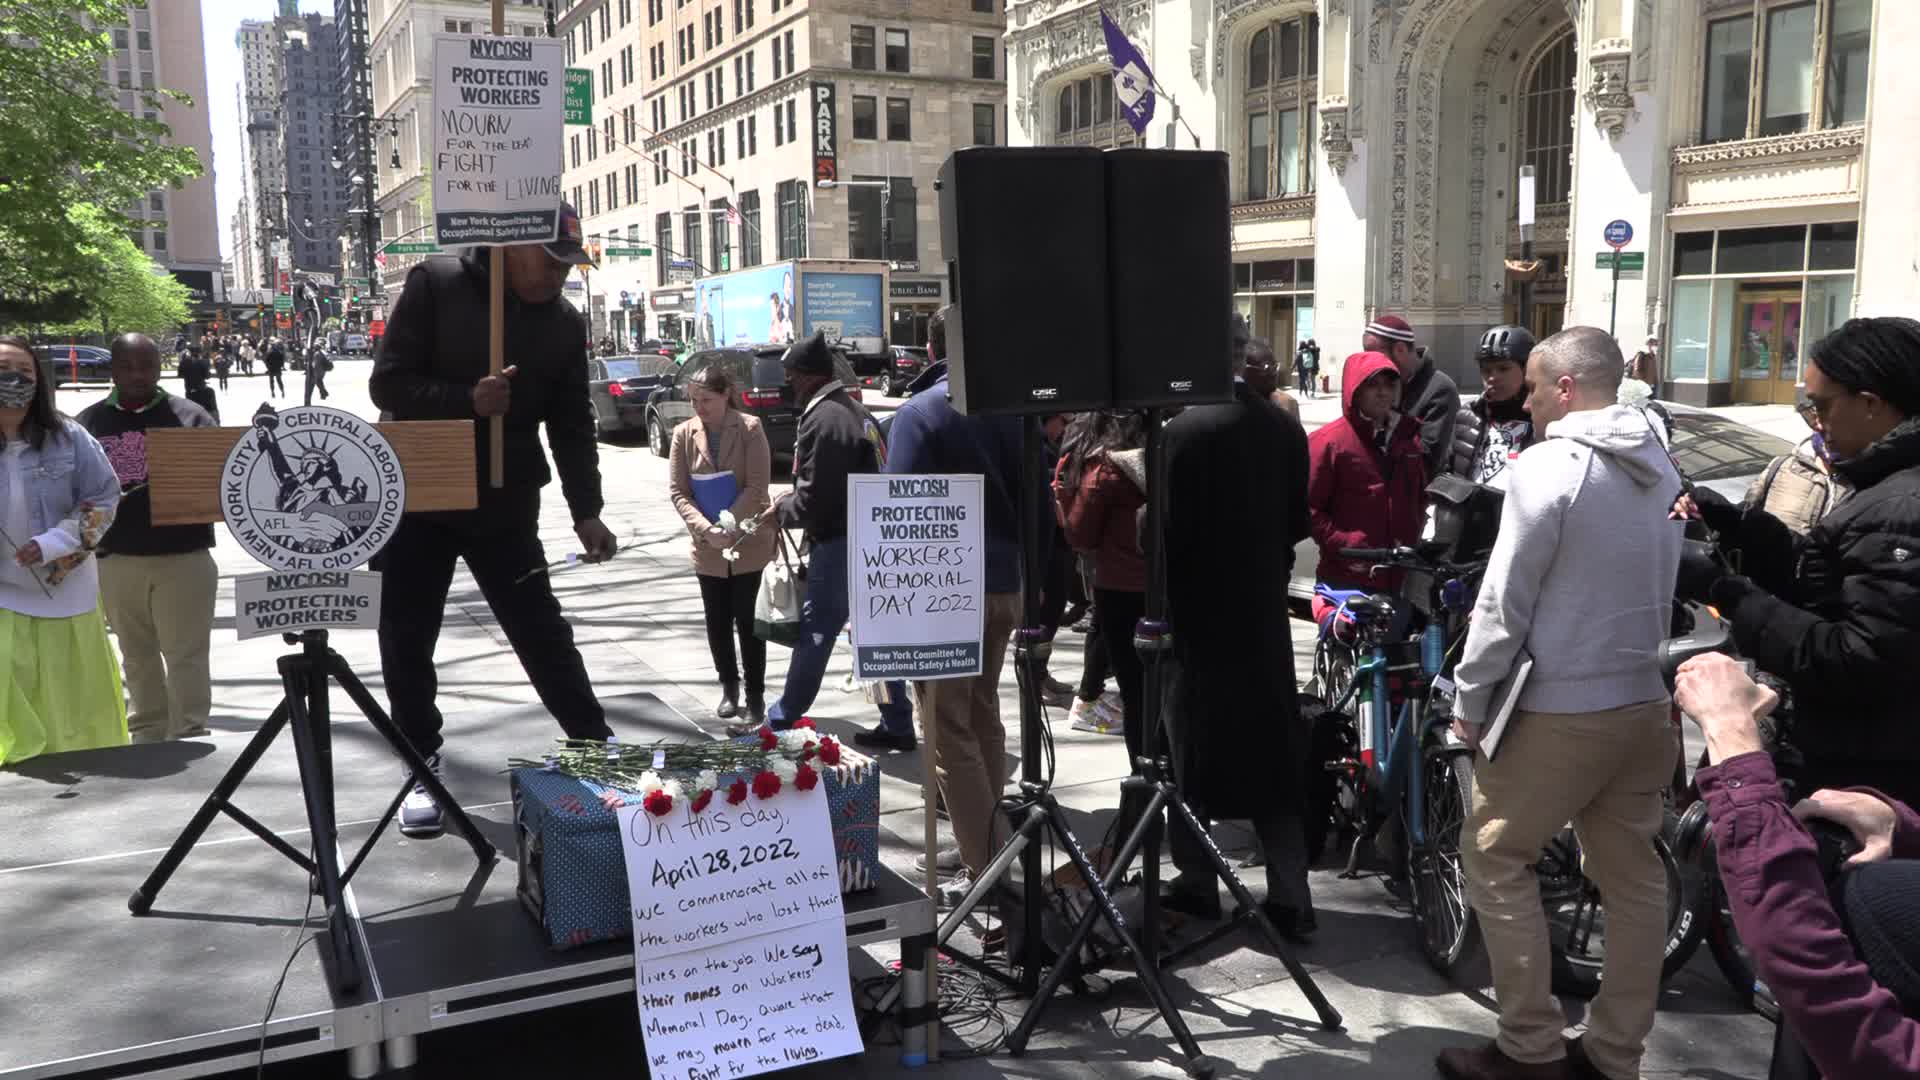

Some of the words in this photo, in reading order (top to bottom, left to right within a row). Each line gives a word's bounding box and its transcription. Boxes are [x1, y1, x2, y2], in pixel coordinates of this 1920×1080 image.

[470, 38, 532, 61] NYCOSH
[452, 66, 549, 87] PROTECTING
[565, 70, 588, 85] ridge
[460, 87, 541, 105] WORKERS
[441, 109, 512, 137] MOURN
[563, 110, 583, 121] EFT
[816, 86, 832, 151] PARK
[446, 138, 476, 150] FOR
[438, 152, 497, 174] FIGHT
[447, 180, 473, 193] FOR
[476, 180, 497, 193] THE
[505, 175, 561, 201] LIVING
[450, 217, 468, 227] New
[469, 216, 489, 226] York
[490, 215, 531, 226] Committee
[532, 215, 544, 224] for
[440, 227, 495, 239] Occupational
[496, 226, 519, 239] Safety
[1032, 388, 1057, 396] QSC
[1170, 380, 1193, 388] QSC
[284, 412, 361, 439] CENTRAL
[230, 439, 256, 477] CITY
[362, 433, 398, 485] LABOR
[888, 479, 949, 498] NYCOSH
[227, 481, 248, 529] YORK
[347, 510, 373, 522] CIO
[871, 505, 966, 522] PROTECTING
[263, 518, 291, 530] AFL
[358, 488, 400, 551] COUNCIL
[879, 523, 959, 540] WORKERS
[240, 528, 278, 560] NEW
[284, 556, 317, 570] AFL
[322, 551, 353, 570] CIO
[862, 545, 973, 568] WORKERS'
[266, 571, 350, 593] NYCOSH
[867, 570, 973, 590] MEMORIAL
[244, 594, 369, 616] PROTECTING
[869, 591, 917, 619] DAY
[924, 593, 977, 614] 2022
[255, 608, 358, 630] WORKERS
[863, 660, 918, 672] Occupational
[919, 659, 944, 671] Safety
[952, 657, 977, 667] Health
[873, 651, 890, 660] New
[892, 651, 911, 660] York
[913, 648, 954, 659] Committee
[955, 647, 967, 657] for
[631, 808, 675, 848] On
[681, 803, 732, 841] this
[651, 855, 702, 890] April
[634, 903, 665, 921] we
[678, 878, 776, 913] commemorate
[785, 869, 808, 886] all
[812, 864, 830, 880] of
[640, 931, 665, 948] the
[674, 921, 730, 943] workers
[735, 911, 764, 927] who
[771, 900, 801, 918] lost
[807, 893, 839, 913] their
[1678, 909, 1693, 940] CST
[640, 964, 677, 986] lives
[683, 966, 698, 979] on
[704, 957, 730, 972] the
[763, 943, 789, 963] We
[791, 943, 823, 968] say
[642, 993, 675, 1011] their
[683, 985, 721, 1004] names
[731, 982, 749, 994] on
[646, 1010, 706, 1038] Memorial
[800, 990, 834, 1005] that
[677, 1049, 706, 1065] may
[713, 1037, 752, 1055] mourn
[757, 1027, 776, 1044] for
[783, 1024, 809, 1039] the
[757, 1055, 779, 1068] the
